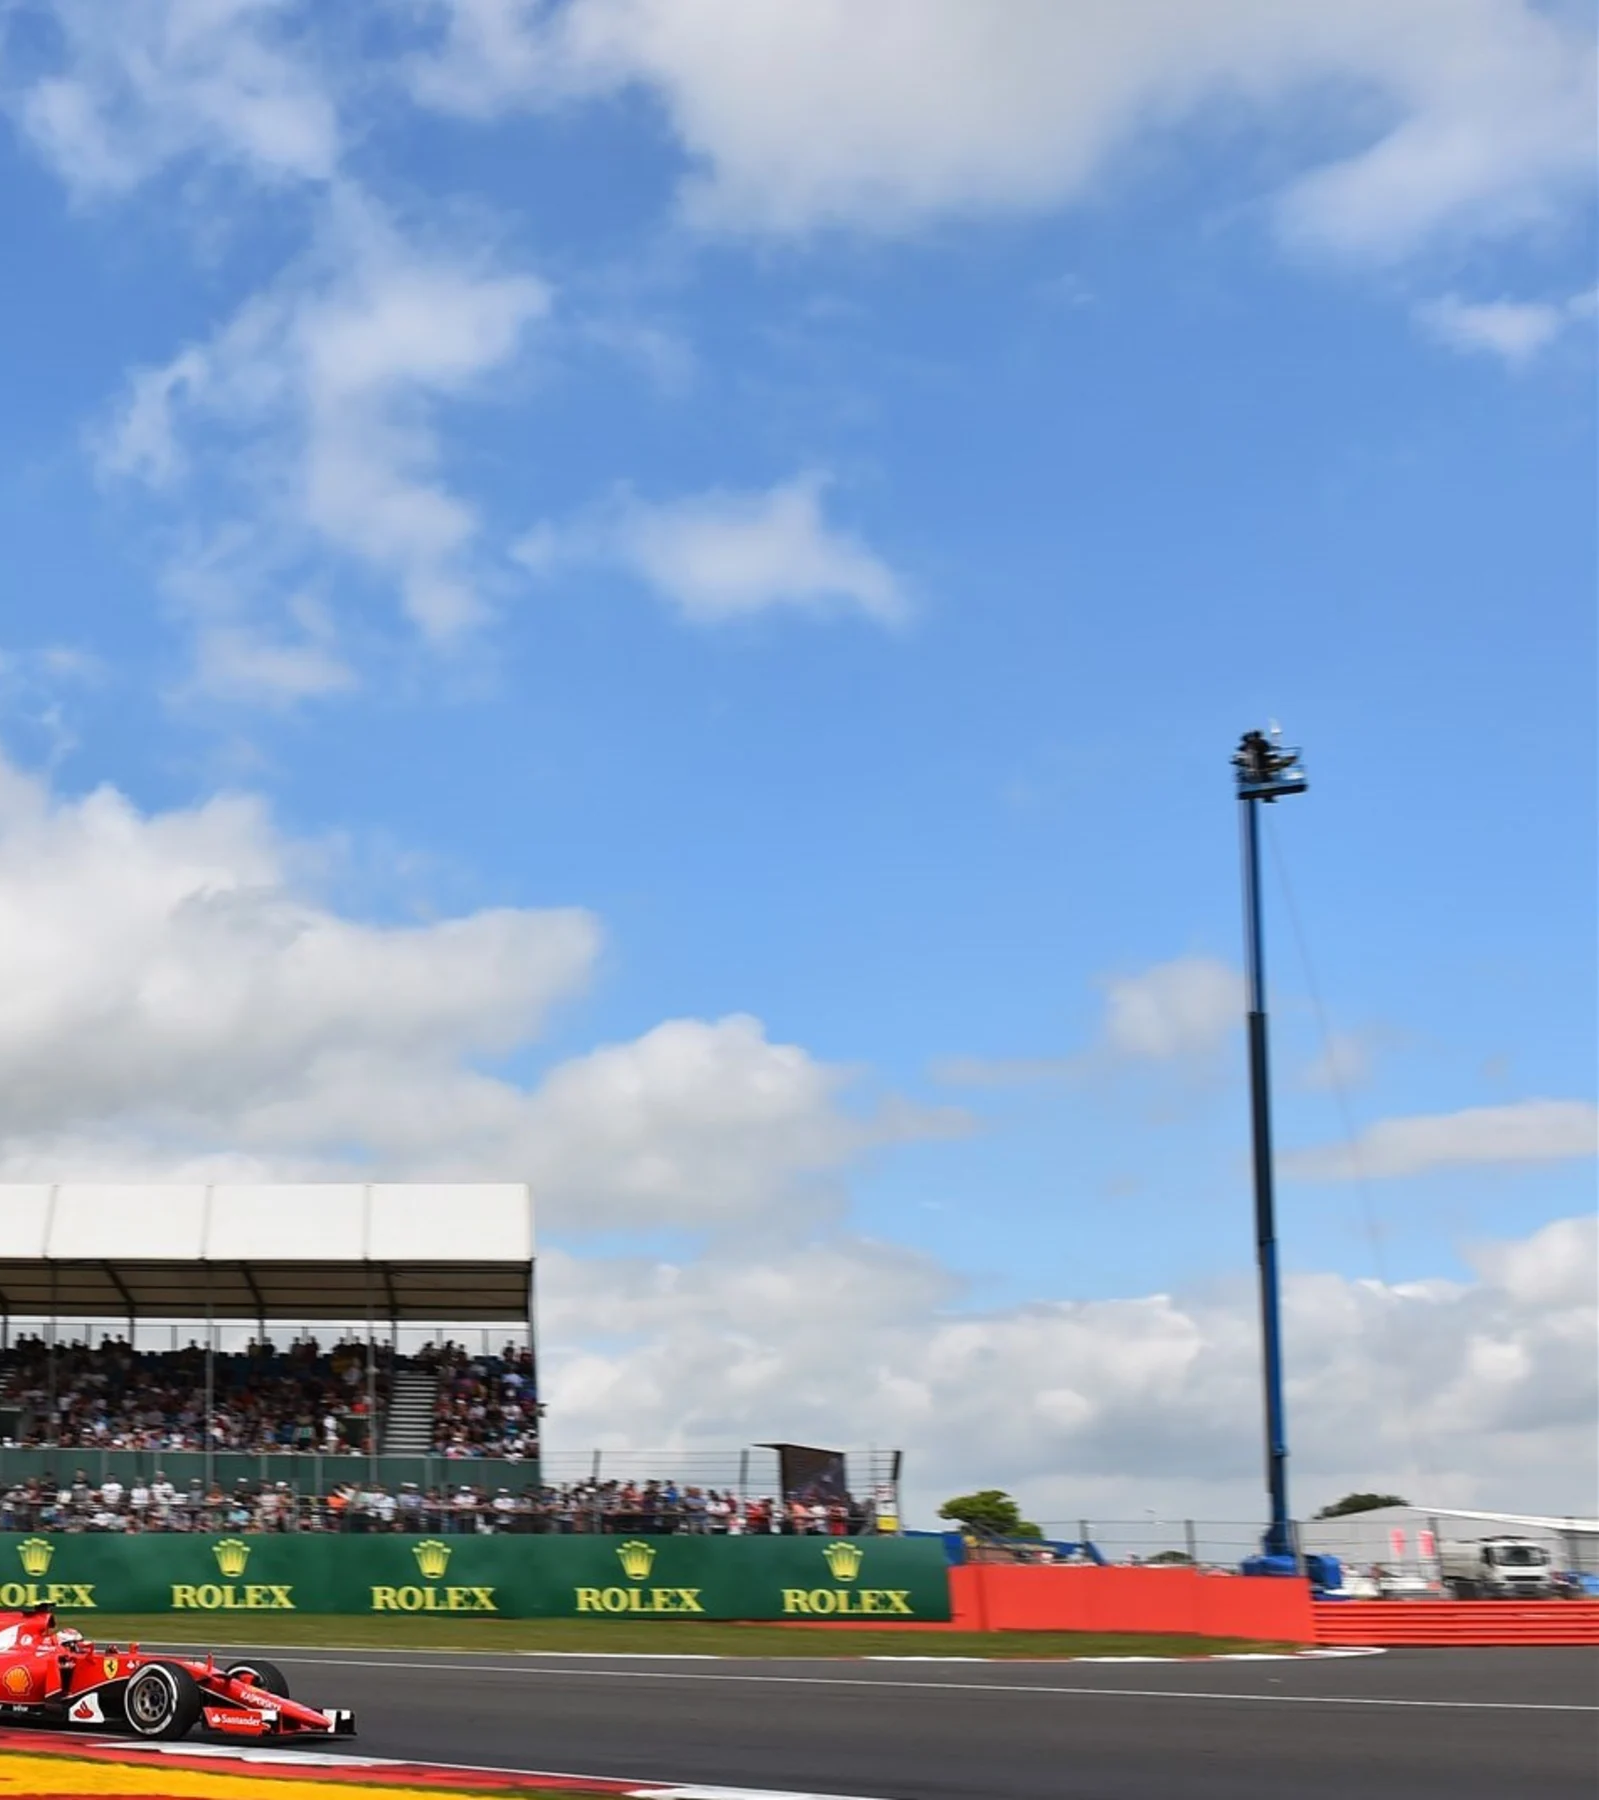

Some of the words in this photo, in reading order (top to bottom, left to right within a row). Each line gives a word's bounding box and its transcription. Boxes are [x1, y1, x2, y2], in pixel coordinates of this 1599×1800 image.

[172, 1584, 294, 1609] ROLEX
[371, 1586, 497, 1611] ROLEX
[576, 1587, 703, 1613] ROLEX
[783, 1588, 912, 1614] ROLEX
[221, 1713, 261, 1727] Santander
